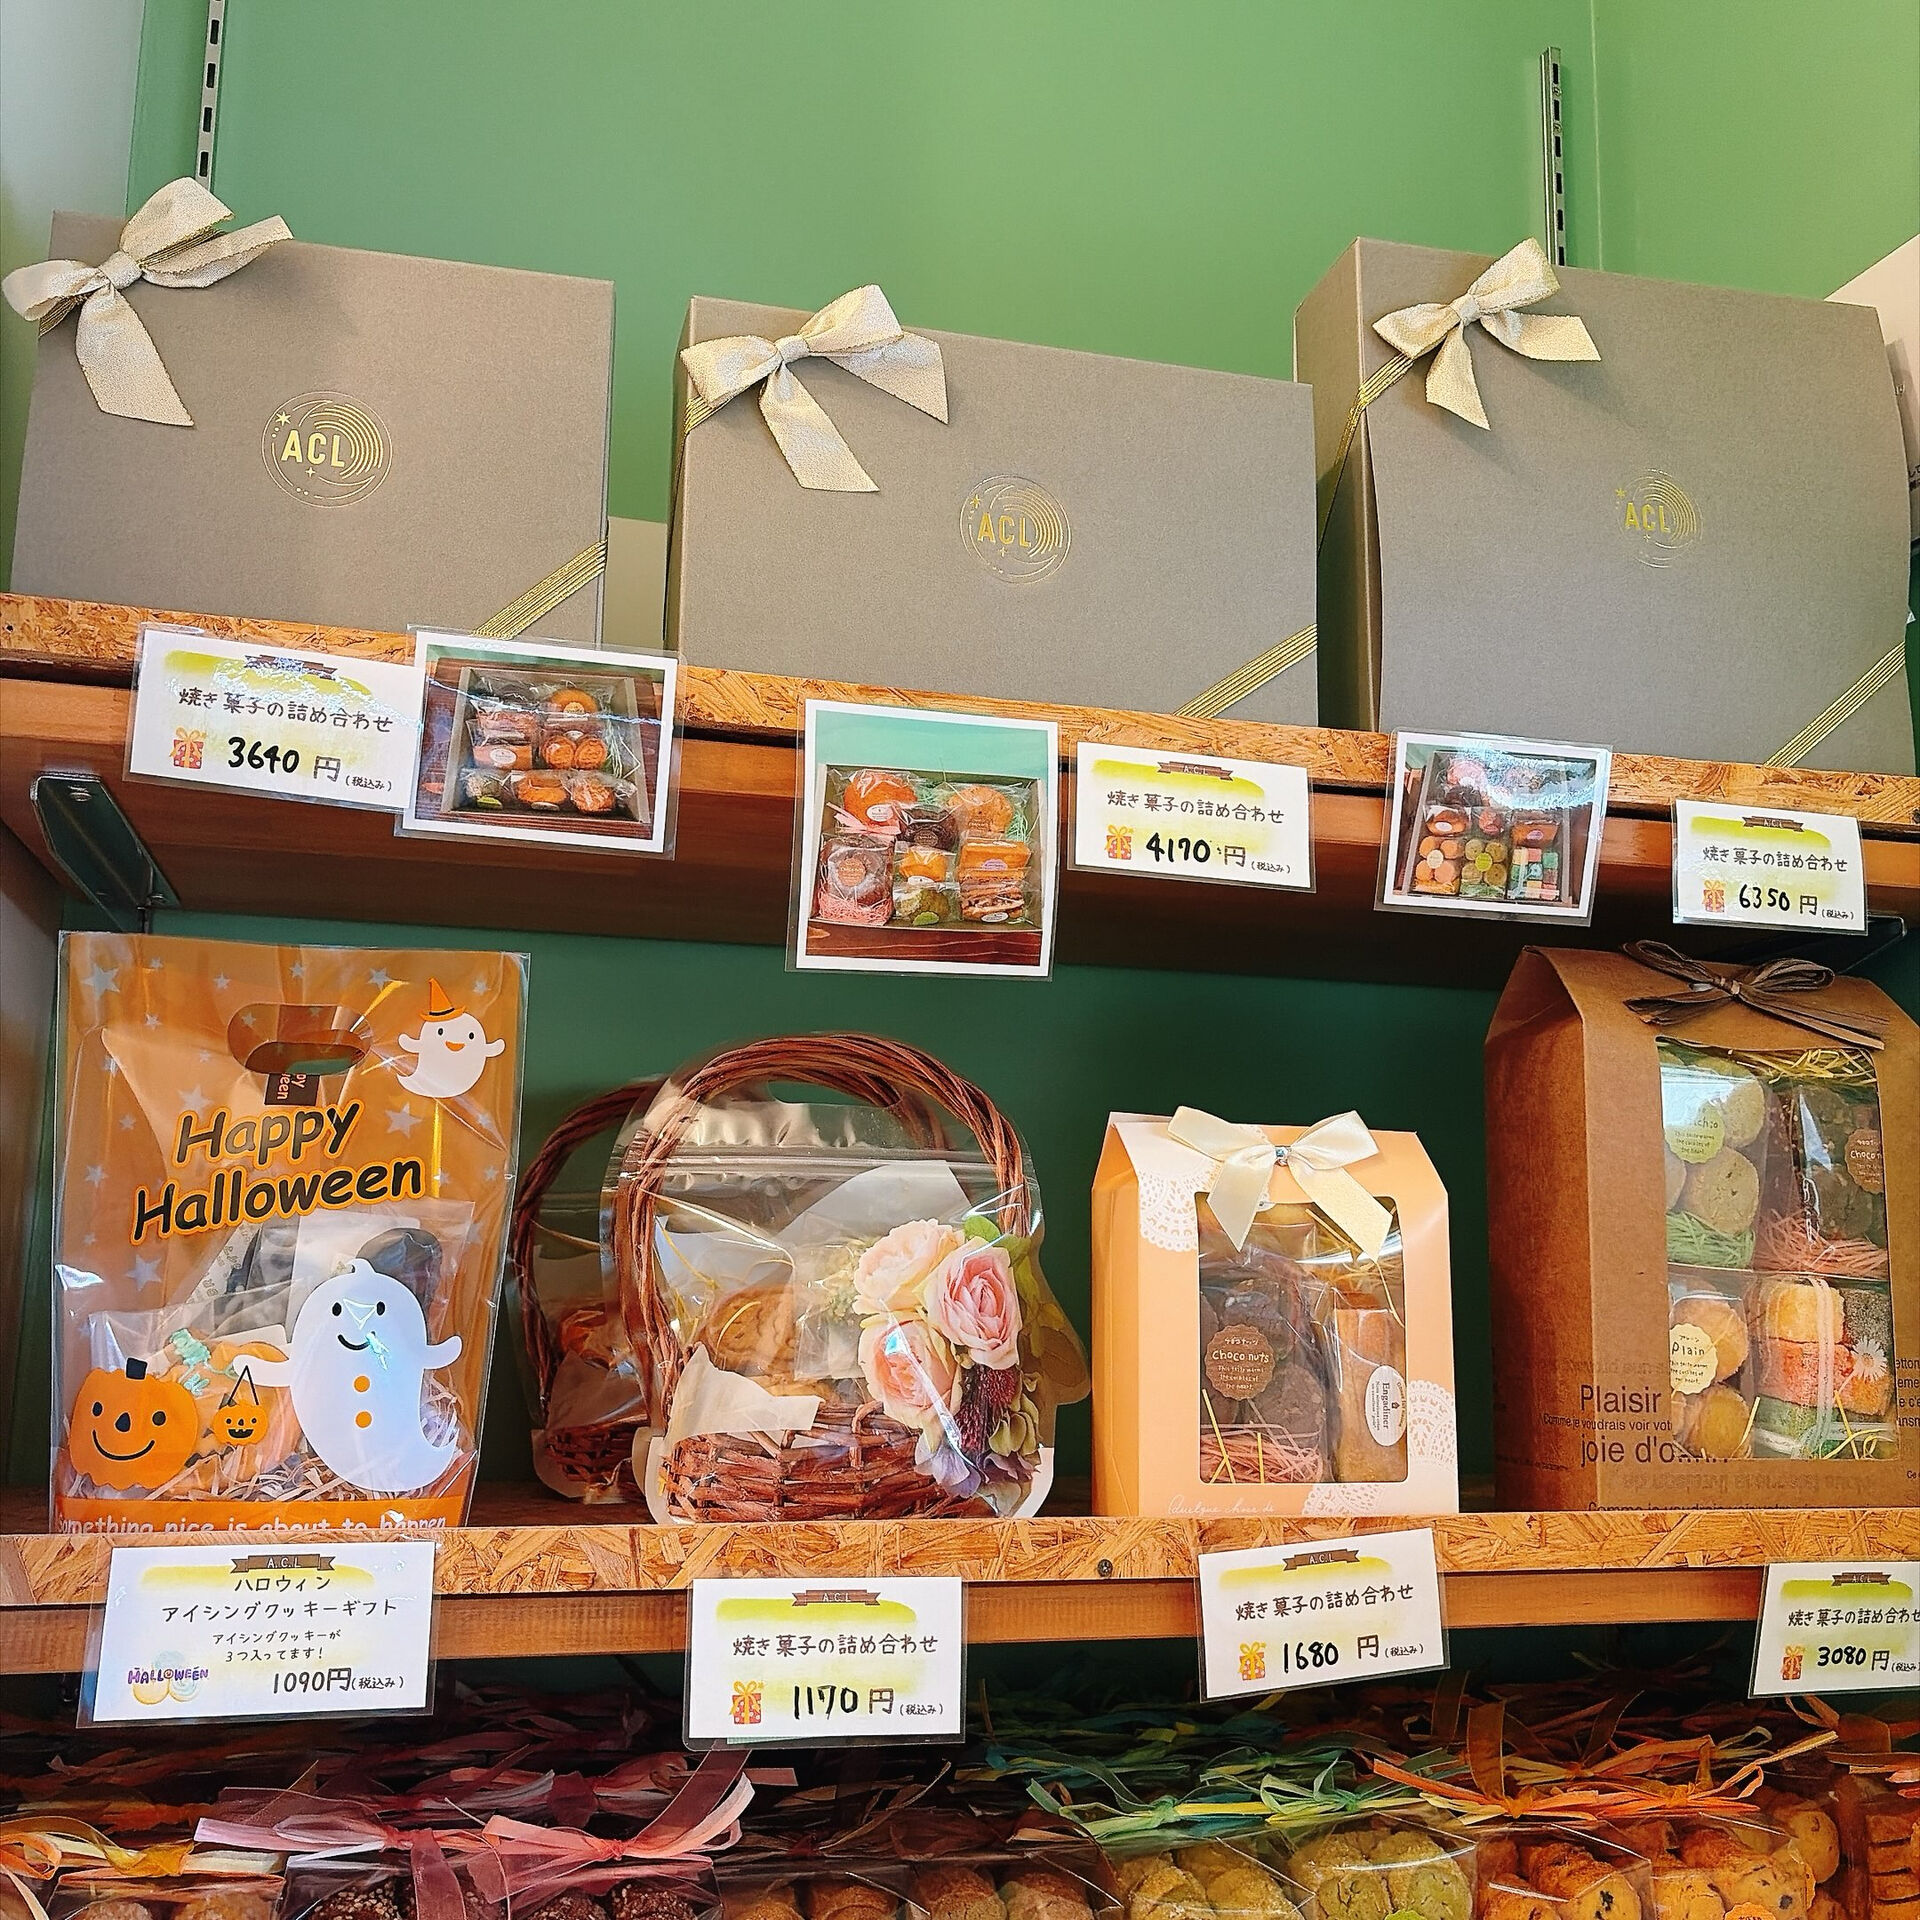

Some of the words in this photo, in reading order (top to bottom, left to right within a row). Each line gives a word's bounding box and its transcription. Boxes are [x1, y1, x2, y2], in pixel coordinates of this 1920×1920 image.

[280, 428, 346, 468] ACL
[977, 511, 1032, 548] ACL
[1624, 502, 1672, 533] ACL
[227, 736, 300, 774] 3640
[1107, 790, 1285, 824] 焼き菓子の詰め合わせ
[1702, 845, 1848, 873] 焼き菓子の詰め合わせ
[1739, 883, 1791, 912] 6350
[173, 1101, 362, 1166] Happy
[132, 1159, 423, 1243] Halloween
[1248, 1351, 1270, 1363] nuts
[1671, 1341, 1705, 1356] Plain
[1381, 1382, 1391, 1430] Engadiner
[1580, 1384, 1662, 1414] Plaisir
[1581, 1419, 1626, 1431] voudrais
[1629, 1419, 1650, 1431] voir
[1580, 1433, 1625, 1468] joie
[234, 1575, 331, 1593] ハロウィン
[161, 1598, 397, 1623] アイシングクッキーギフト
[1235, 1583, 1414, 1622] 焼き菓子の詰め合わせ
[212, 1628, 342, 1646] アイシングクッキーが
[732, 1632, 939, 1658] 焼き菓子の詰め合わせ
[1283, 1641, 1339, 1674] 1680
